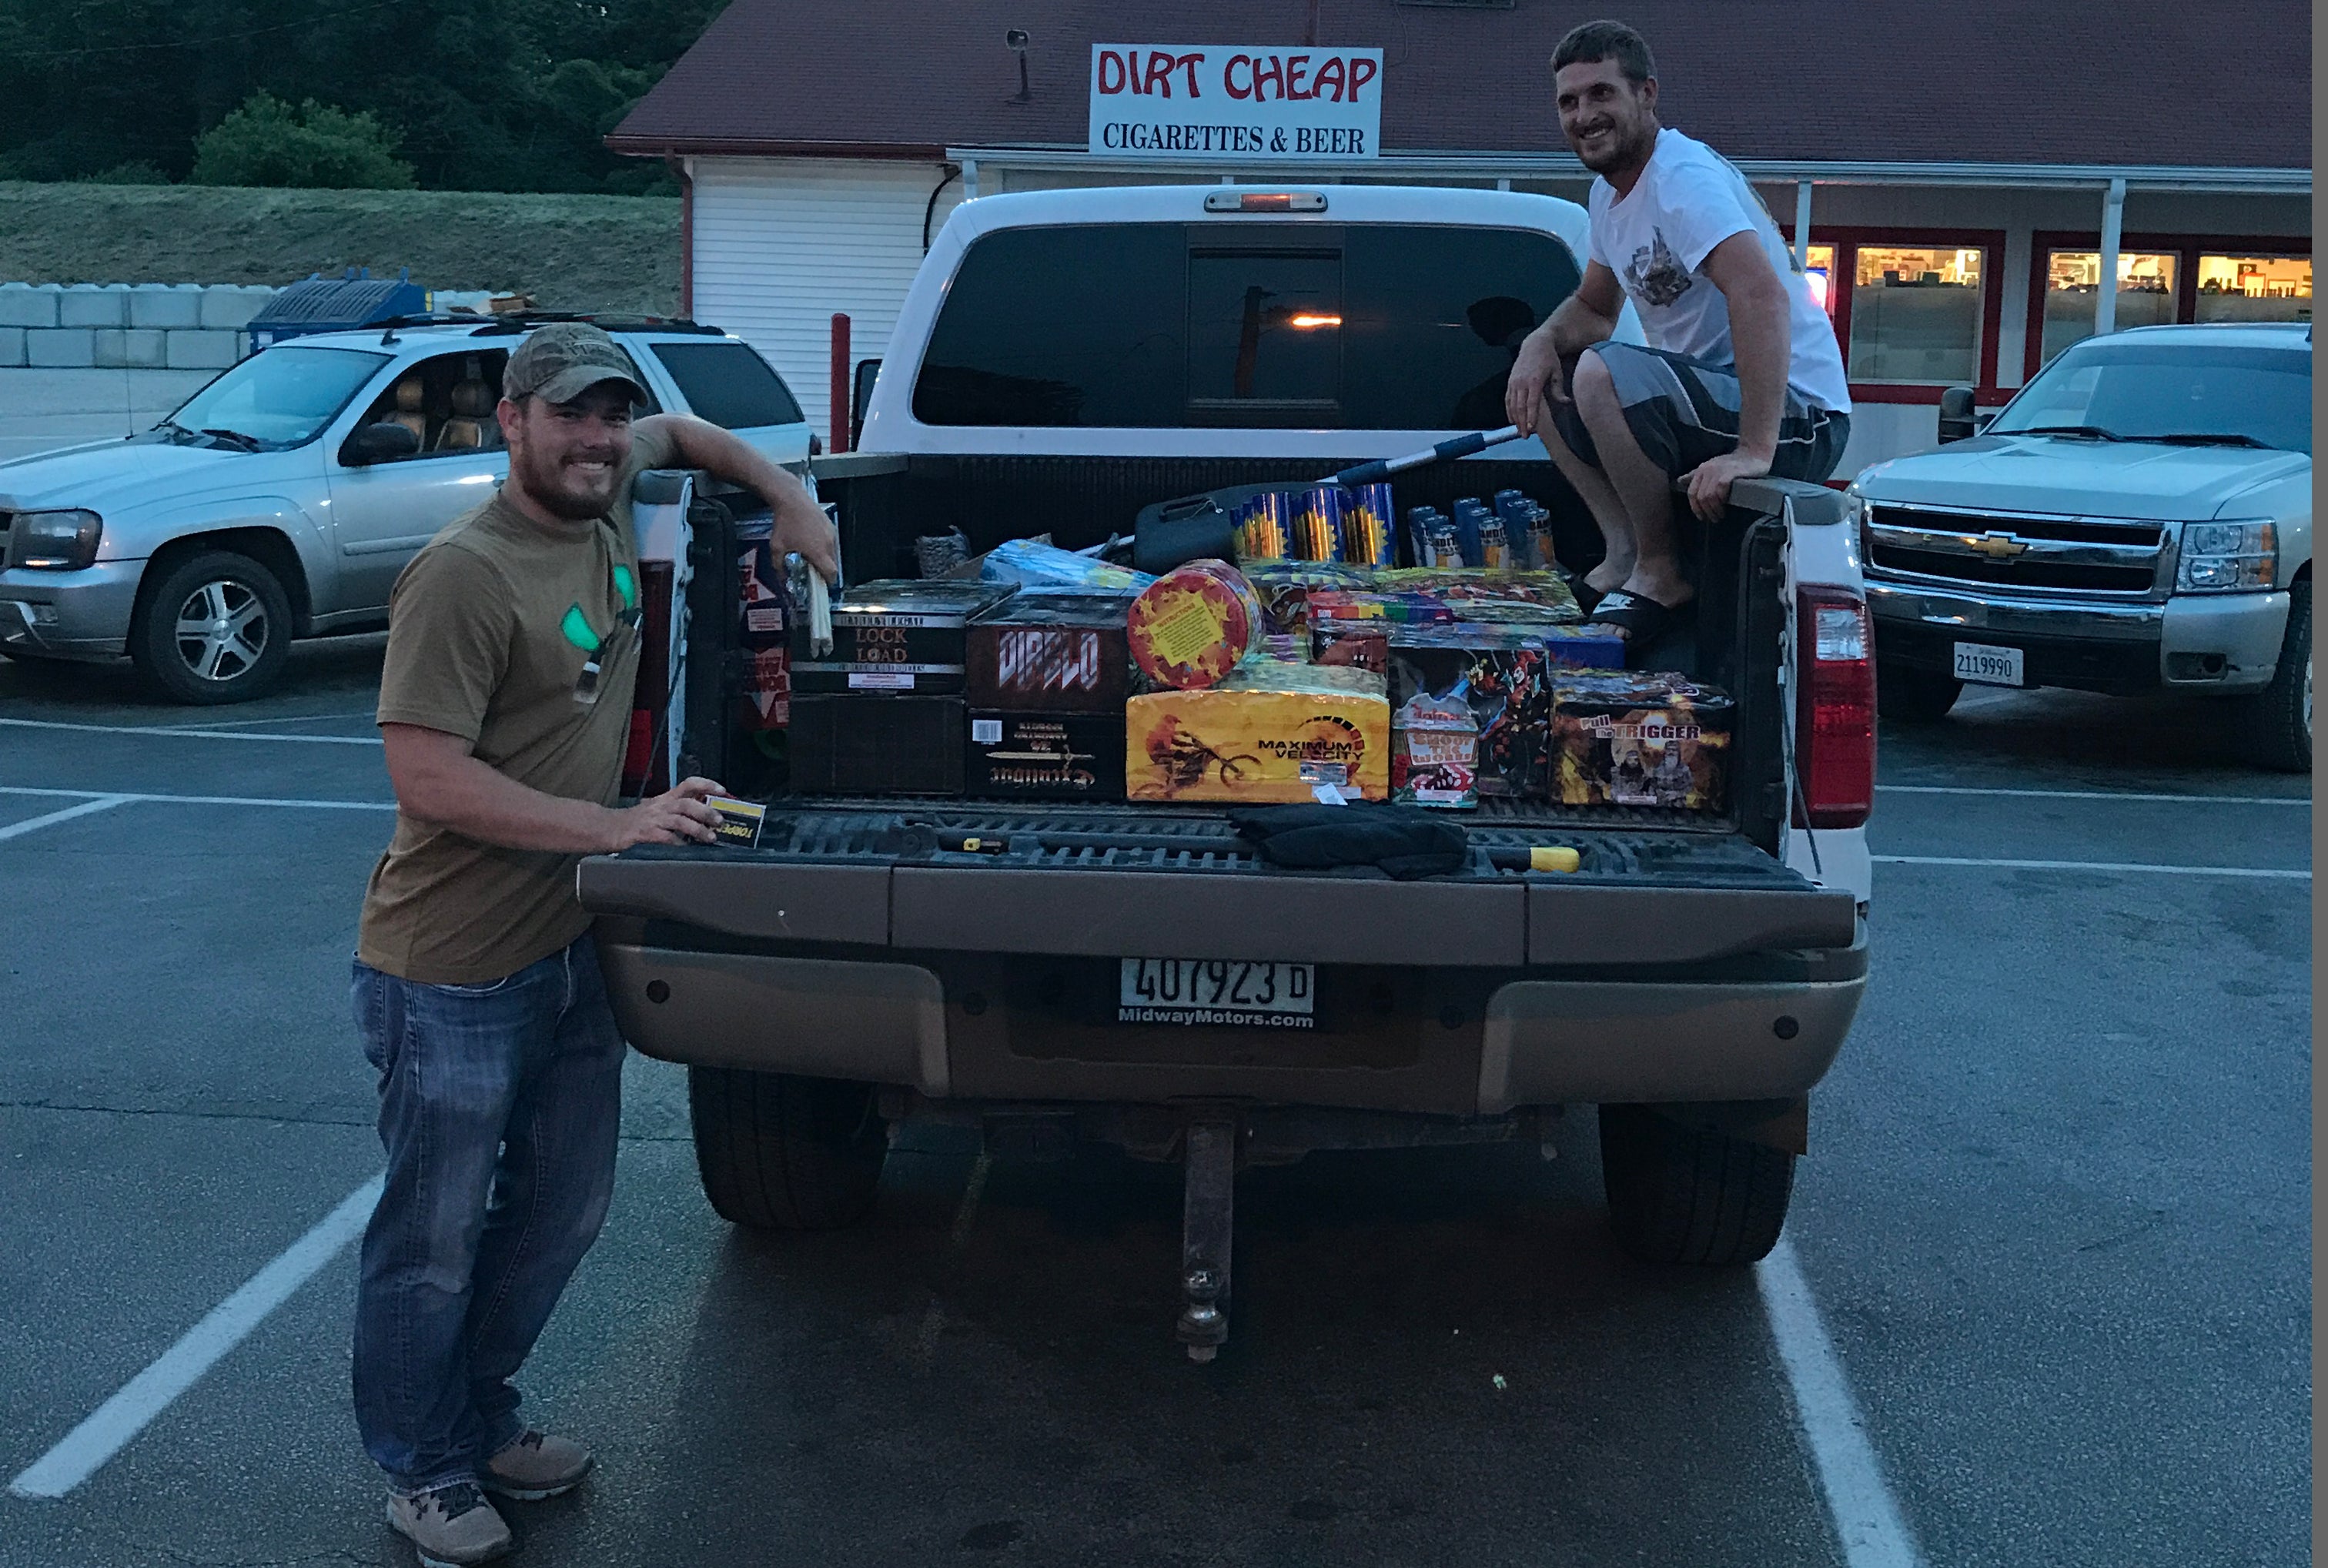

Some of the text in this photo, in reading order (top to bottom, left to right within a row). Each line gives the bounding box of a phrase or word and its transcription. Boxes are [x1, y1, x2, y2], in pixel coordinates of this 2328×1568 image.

[1098, 50, 1378, 103] DIRT CHEAP
[1102, 122, 1365, 155] CIGARETTES & BEER
[855, 627, 908, 644] LOCK
[856, 647, 908, 663] LOAD
[998, 630, 1099, 691] DIABLO
[1957, 654, 2012, 677] 2119990
[1580, 714, 1611, 731] Pull
[1413, 732, 1471, 746] SHOOT
[1612, 724, 1701, 741] TRIGGER
[1258, 740, 1353, 751] MAXIMUM
[1275, 750, 1365, 761] VELOCITY
[1136, 960, 1308, 1005] 407923 D
[1118, 1008, 1313, 1028] MidwayMotors.com
